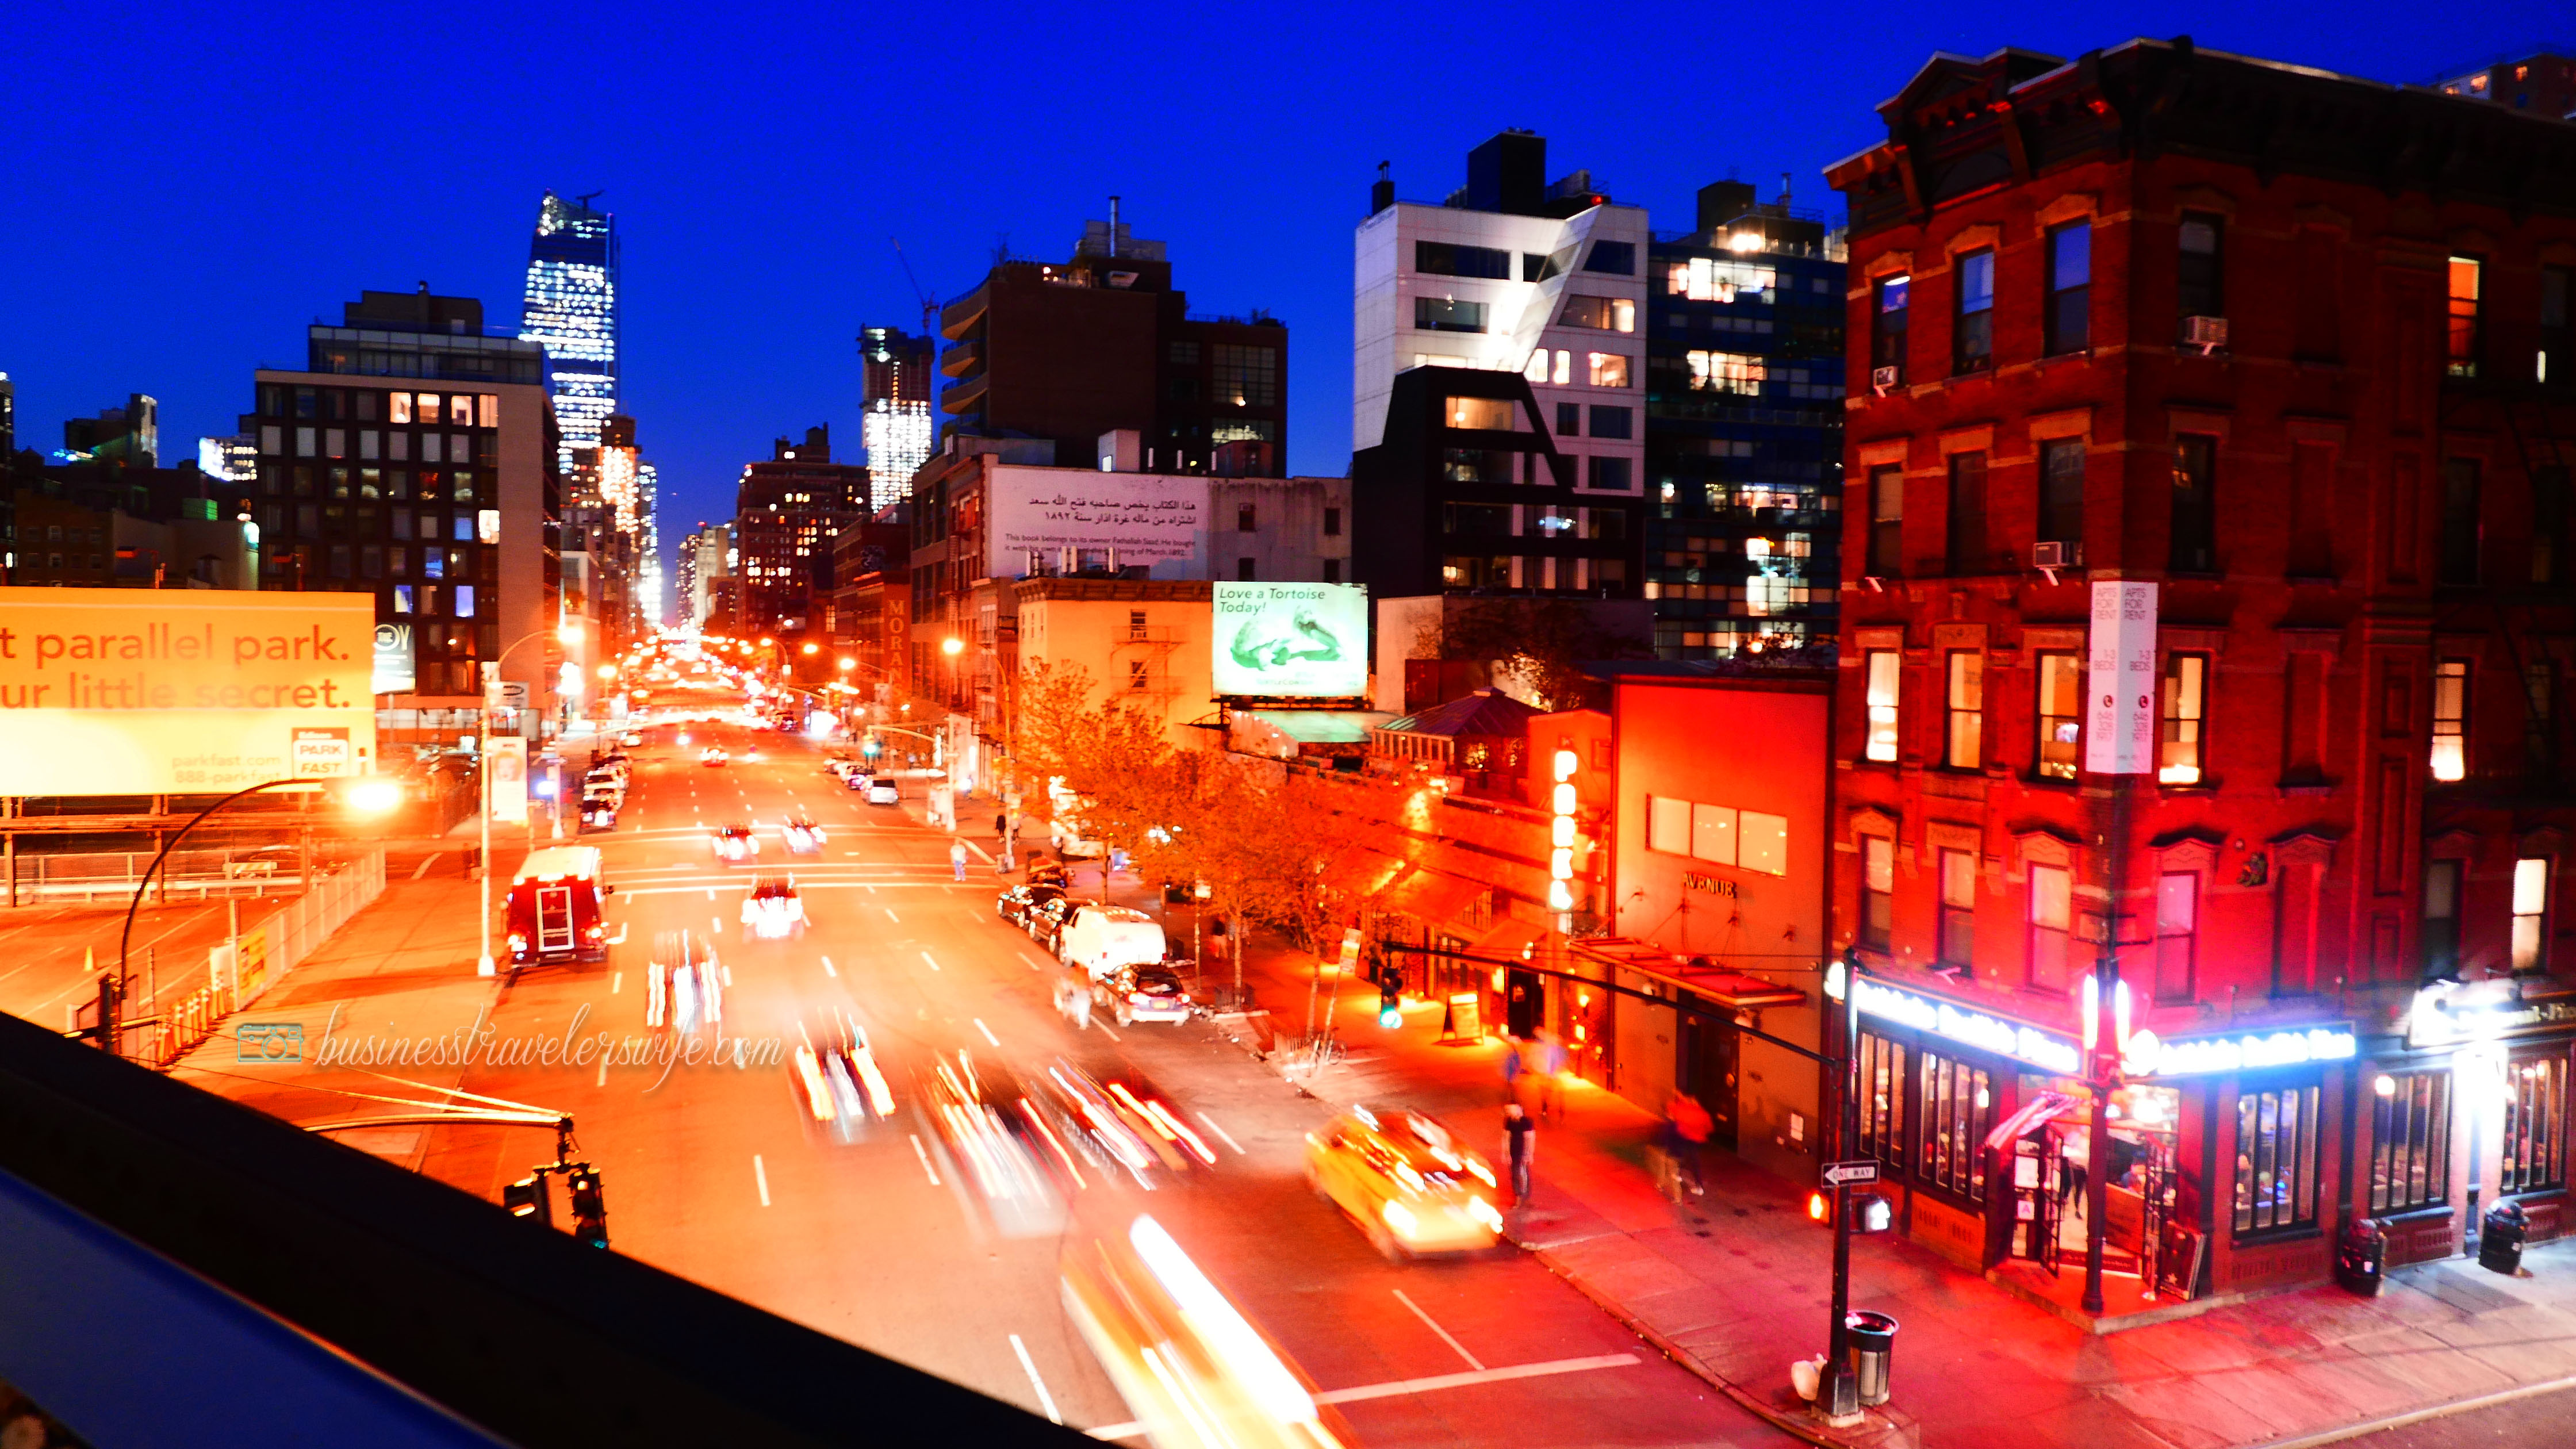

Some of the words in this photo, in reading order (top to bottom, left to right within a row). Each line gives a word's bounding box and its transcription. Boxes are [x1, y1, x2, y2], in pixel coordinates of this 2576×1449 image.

[1006, 533, 1019, 541] This
[1042, 535, 1067, 544] belongs
[1220, 588, 1252, 599] Love
[1257, 590, 1264, 599] a
[1270, 588, 1325, 600] Tortoise
[1220, 601, 1267, 616] Today!
[35, 622, 213, 670] parallel
[234, 624, 350, 670] park.
[70, 671, 178, 709] little
[195, 678, 351, 709] secret.
[299, 745, 343, 754] PARK
[172, 753, 281, 769] parkfast.com
[300, 762, 342, 773] FAST
[175, 770, 281, 785] 888-parkfast
[1682, 872, 1735, 898] AVENUE
[1833, 1170, 1849, 1180] ONE
[1853, 1168, 1870, 1177] WAY
[2022, 1204, 2030, 1214] A
